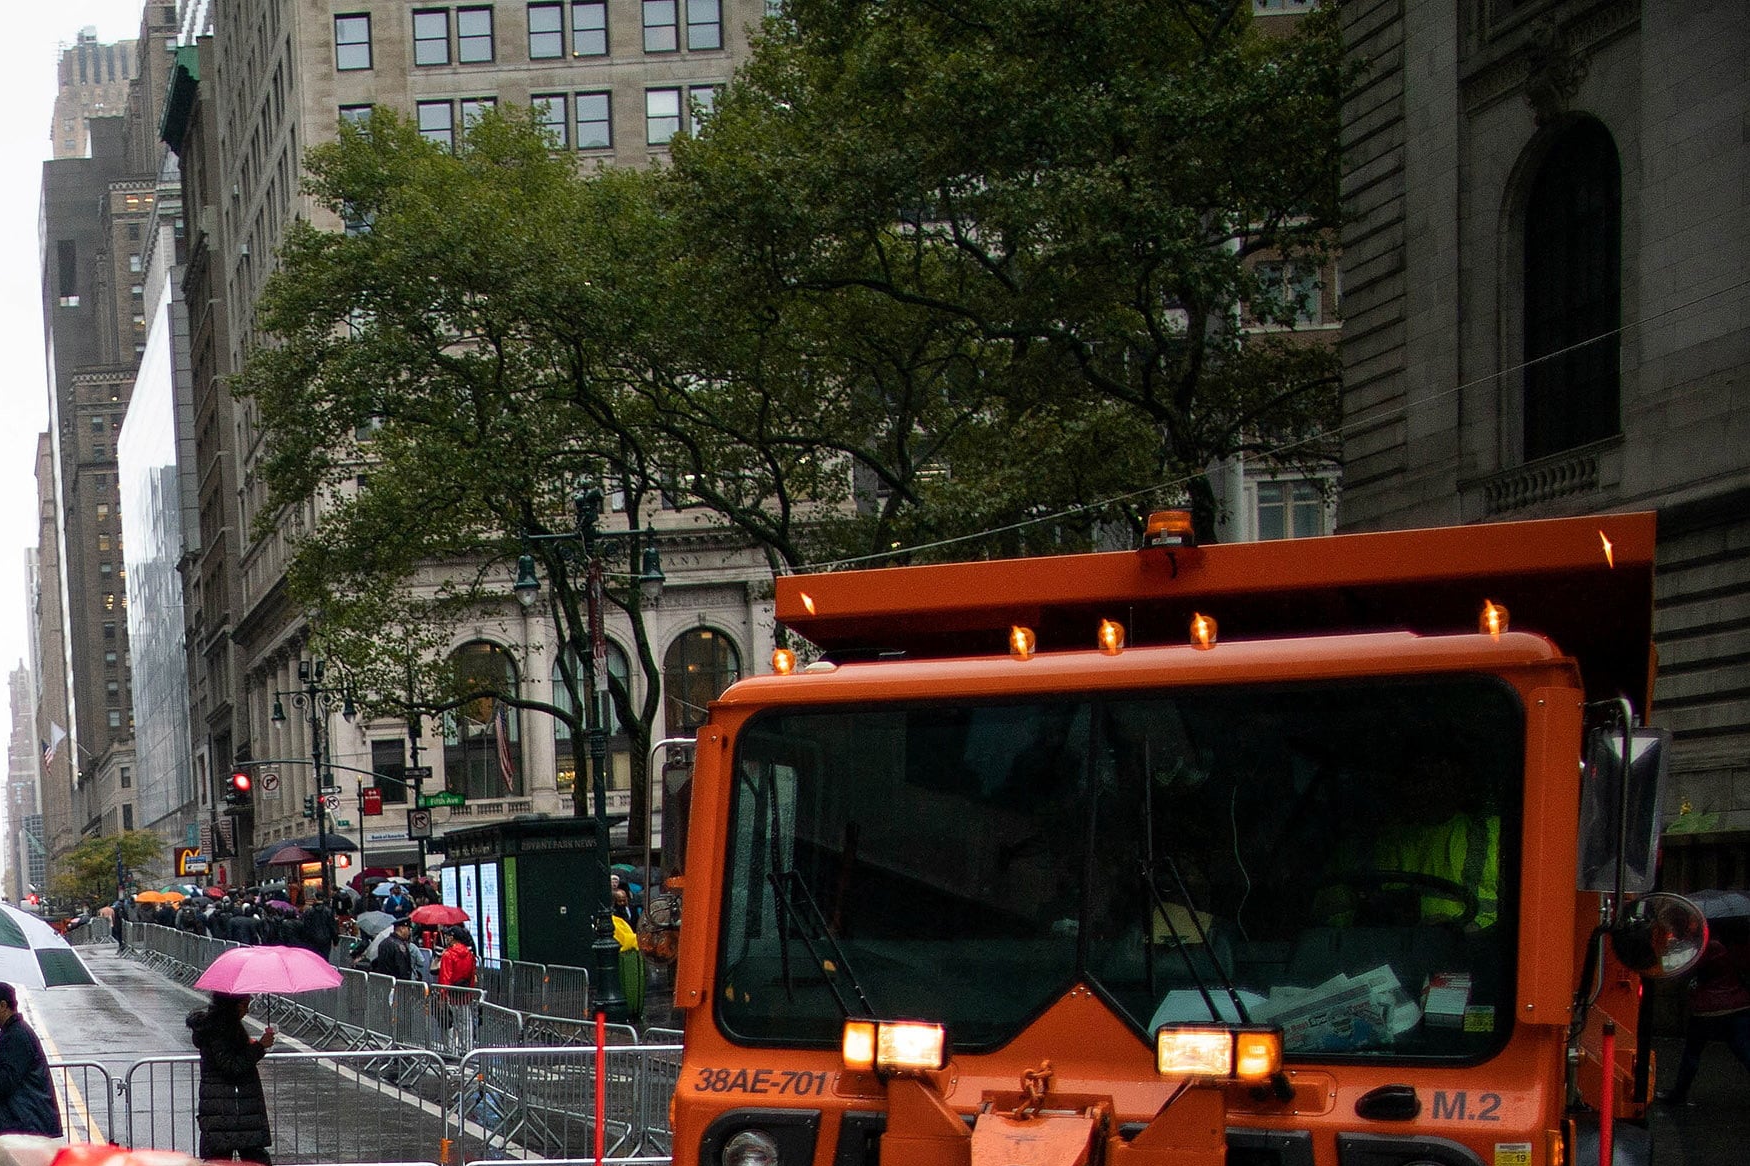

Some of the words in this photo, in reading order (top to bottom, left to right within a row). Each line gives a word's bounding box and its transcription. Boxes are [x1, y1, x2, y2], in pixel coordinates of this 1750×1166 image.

[575, 838, 597, 848] NEWS
[695, 1067, 827, 1096] 38AE-701
[1432, 1091, 1502, 1121] M.2
